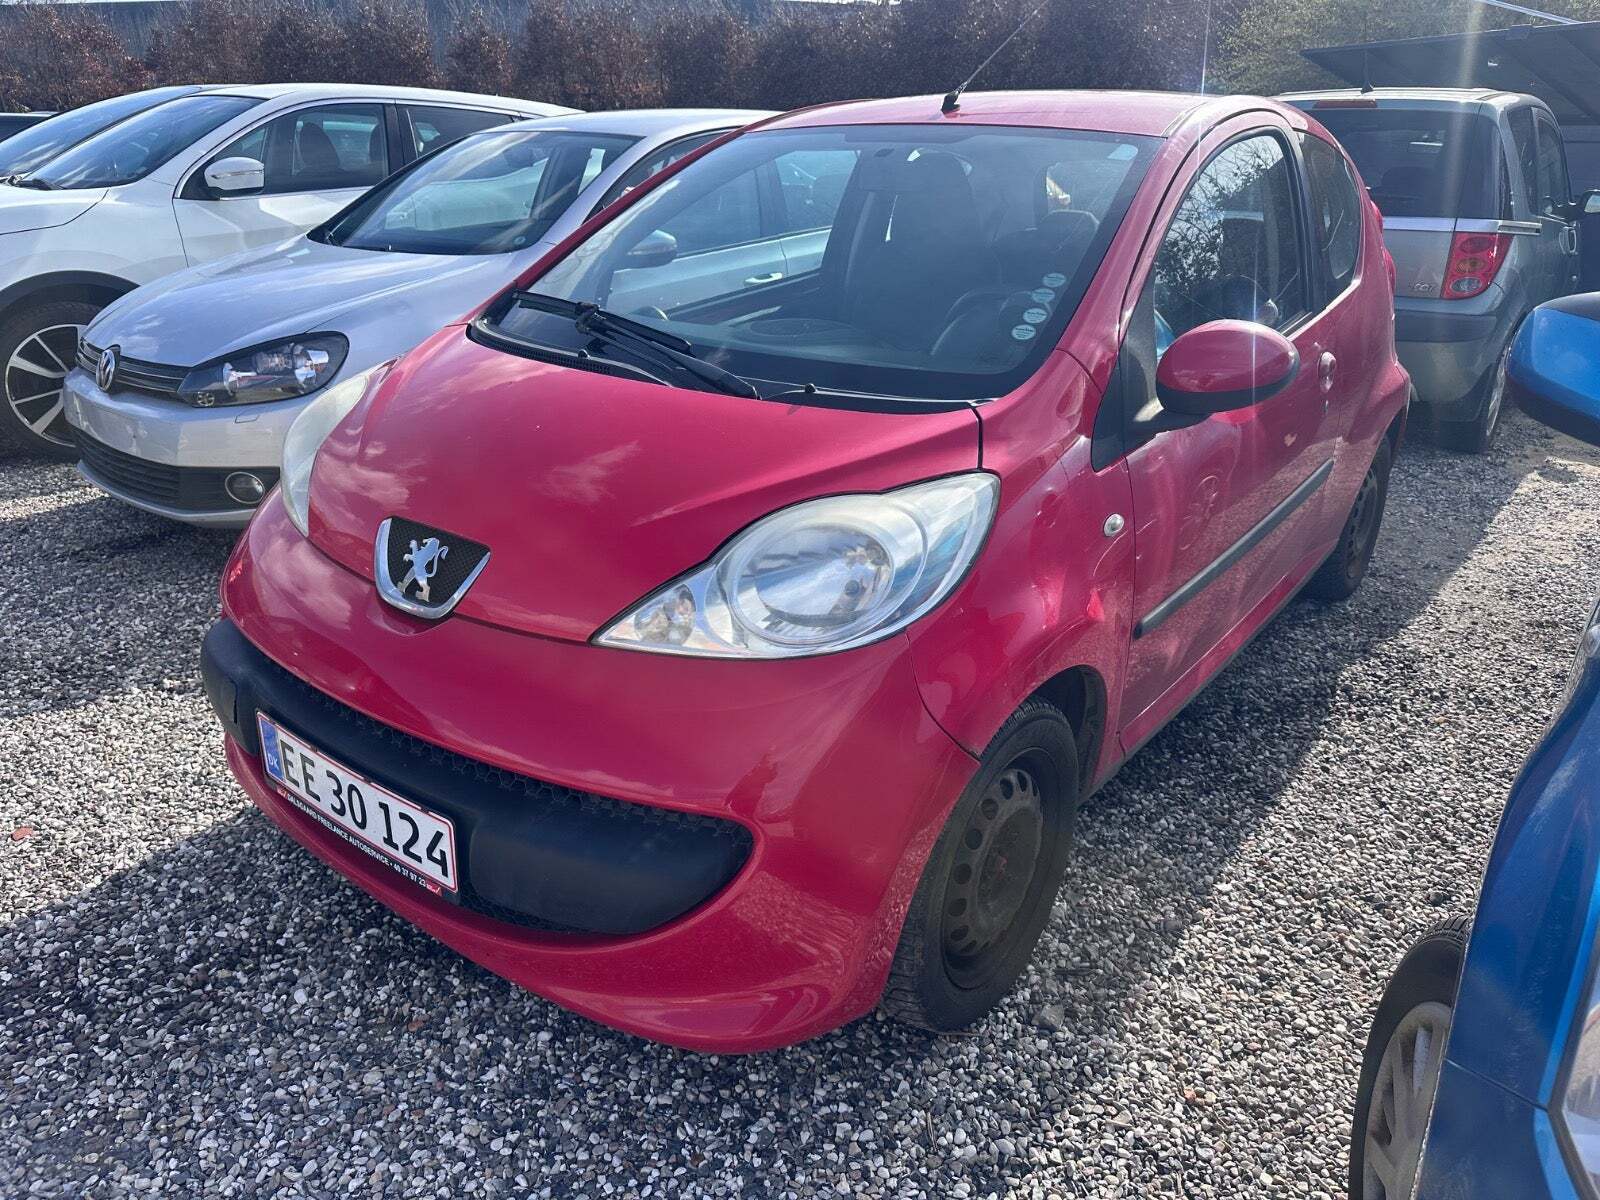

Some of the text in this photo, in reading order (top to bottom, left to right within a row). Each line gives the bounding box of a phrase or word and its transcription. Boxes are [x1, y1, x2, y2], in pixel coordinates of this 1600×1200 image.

[267, 752, 280, 771] DK
[280, 739, 449, 878] EE 30 124
[317, 814, 349, 841] FREELANCE
[349, 835, 390, 867] AUTOSERVICE
